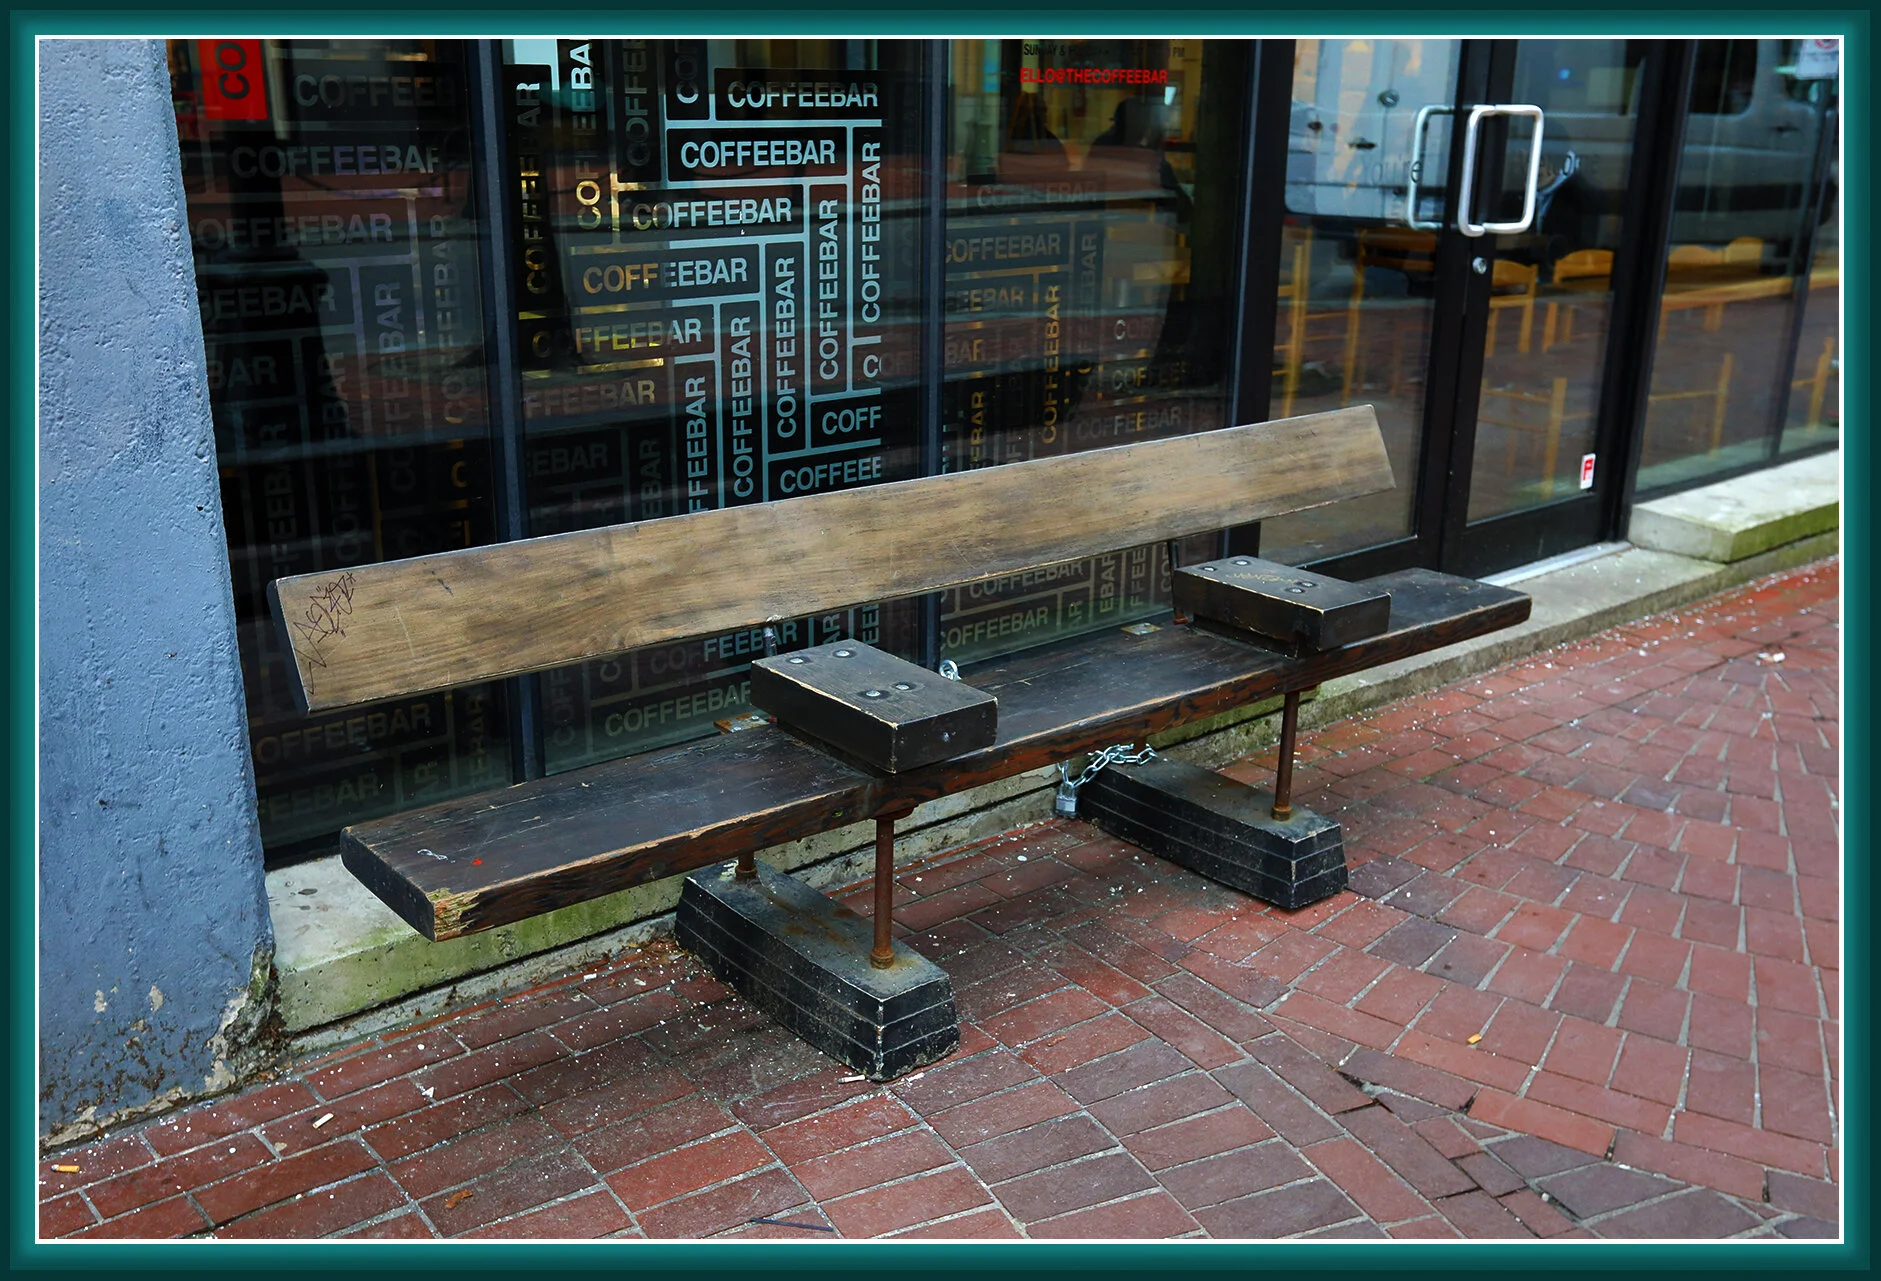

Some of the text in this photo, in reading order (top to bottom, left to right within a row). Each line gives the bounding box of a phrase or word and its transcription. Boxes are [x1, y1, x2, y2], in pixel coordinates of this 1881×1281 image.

[727, 81, 880, 110] COFFEEBAR
[680, 139, 837, 170] COFFEEBAR
[632, 197, 793, 232] COFFEEBAR
[861, 141, 882, 324] COFFEEBAR
[582, 256, 749, 294] COFFEEBAR
[818, 198, 840, 381] COFFEEBAR
[775, 255, 798, 440] COFFEEBAR
[730, 314, 755, 498] COFFEEBAR
[821, 405, 882, 437] COFF
